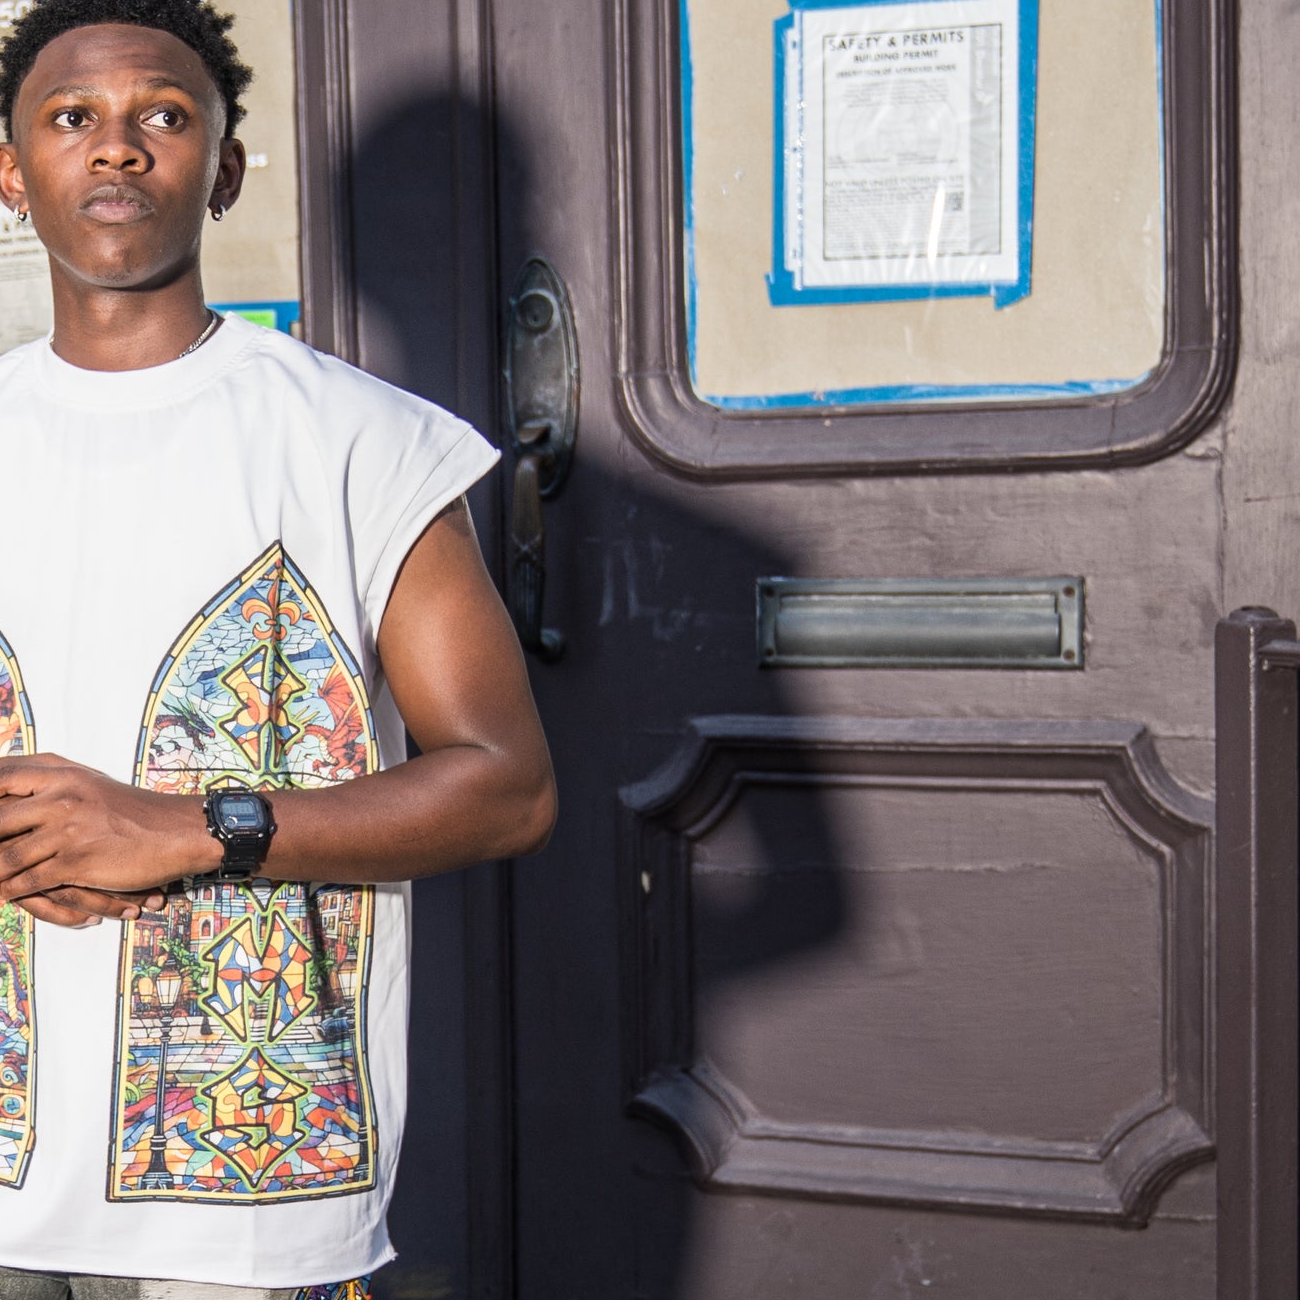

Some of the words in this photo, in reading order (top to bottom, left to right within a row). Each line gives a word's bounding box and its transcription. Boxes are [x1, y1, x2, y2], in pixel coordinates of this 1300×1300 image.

[828, 35, 880, 51] SAFETY
[887, 37, 896, 47] &
[903, 31, 965, 47] PERMITS
[903, 50, 940, 61] PERMIT
